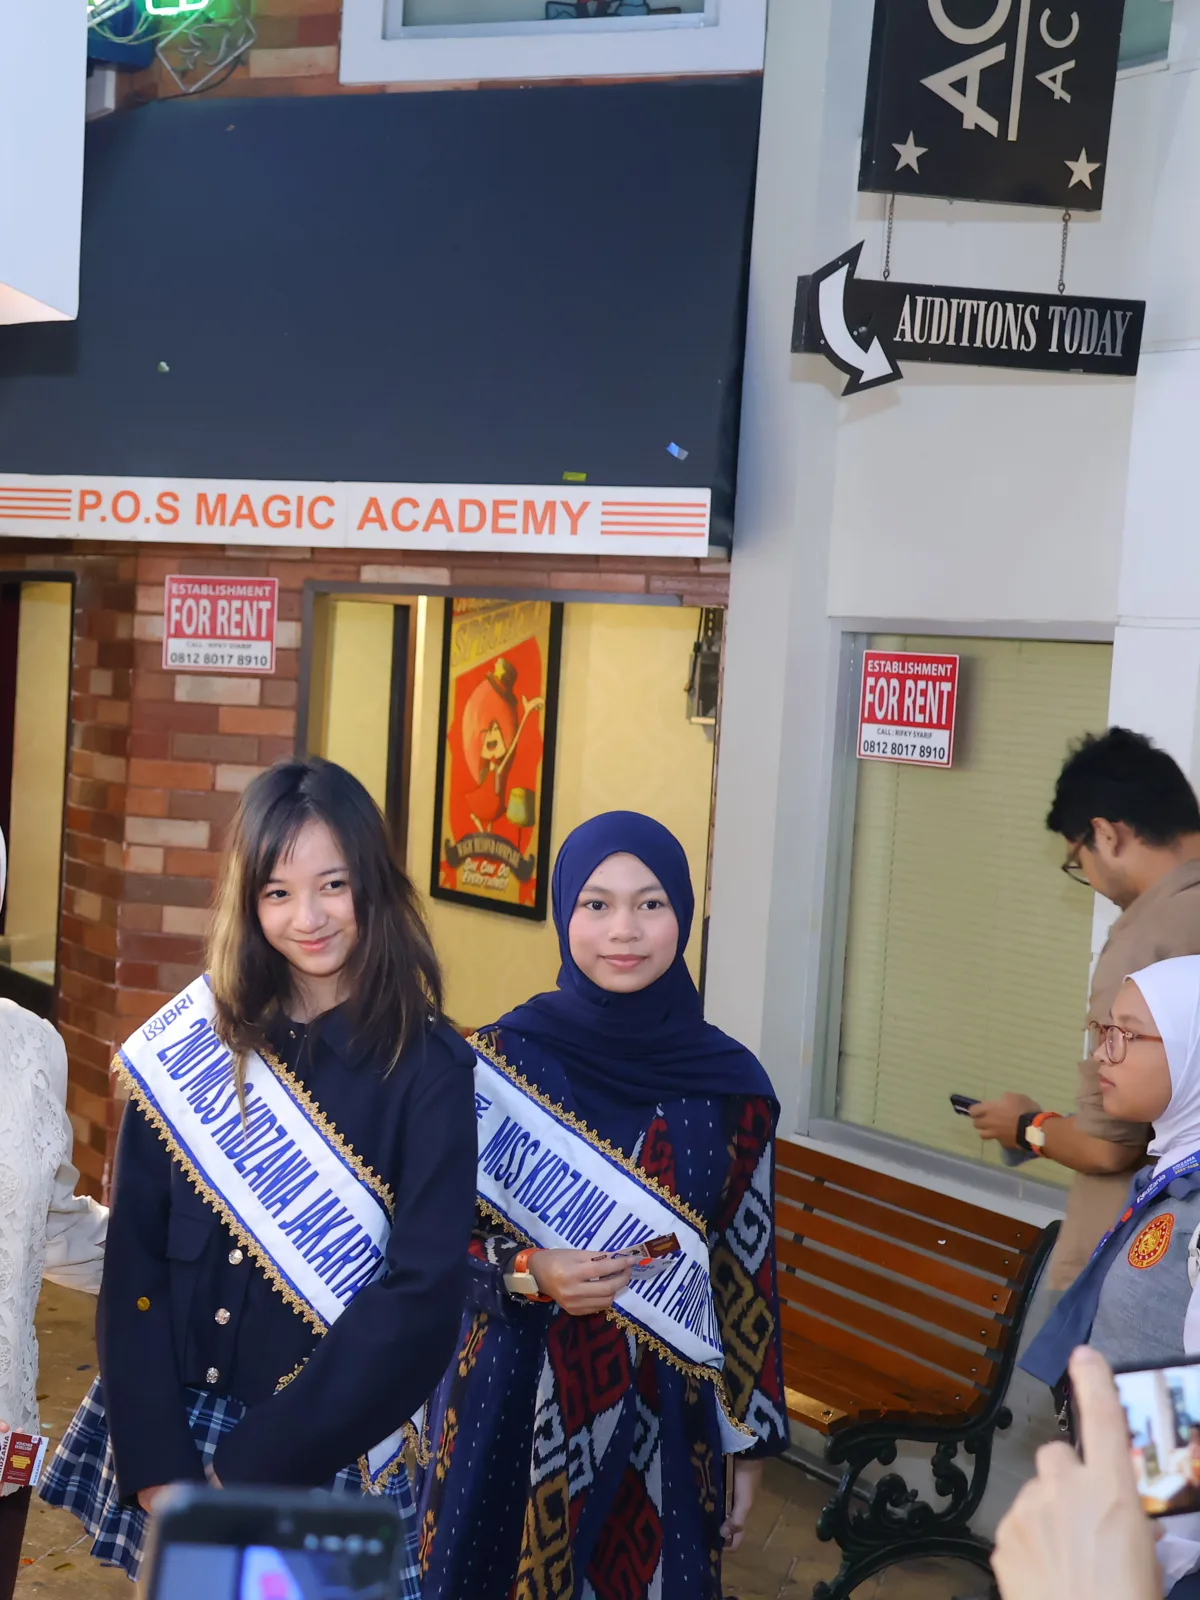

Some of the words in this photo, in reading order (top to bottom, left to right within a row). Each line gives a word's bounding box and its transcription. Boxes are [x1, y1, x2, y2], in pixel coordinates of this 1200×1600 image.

[894, 295, 1039, 352] AUDITIONS
[1047, 305, 1133, 357] TODAY
[77, 489, 180, 525] P.O.S
[195, 492, 335, 531] MAGIC
[357, 496, 591, 536] ACADEMY
[171, 583, 271, 597] ESTABLISHMENT
[170, 598, 211, 636] FOR
[216, 599, 272, 638] RENT
[170, 653, 200, 664] 0812
[203, 653, 233, 665] 8017
[237, 656, 268, 667] 8910
[868, 660, 953, 677] ESTABLISHMENT
[864, 677, 900, 721] FOR
[903, 679, 952, 725] RENT
[863, 740, 888, 754] 0812
[891, 743, 916, 757] 8017
[919, 745, 945, 760] 8910
[877, 728, 891, 736] CALL
[162, 993, 195, 1027] BRI
[156, 1017, 225, 1082] 2ND
[179, 1051, 254, 1125] MISS
[475, 1092, 493, 1120] RI
[211, 1096, 320, 1220] KIDZANIA
[478, 1115, 541, 1191] MISS
[513, 1148, 618, 1251] KIDZANIA
[277, 1188, 386, 1307] JAKARTA
